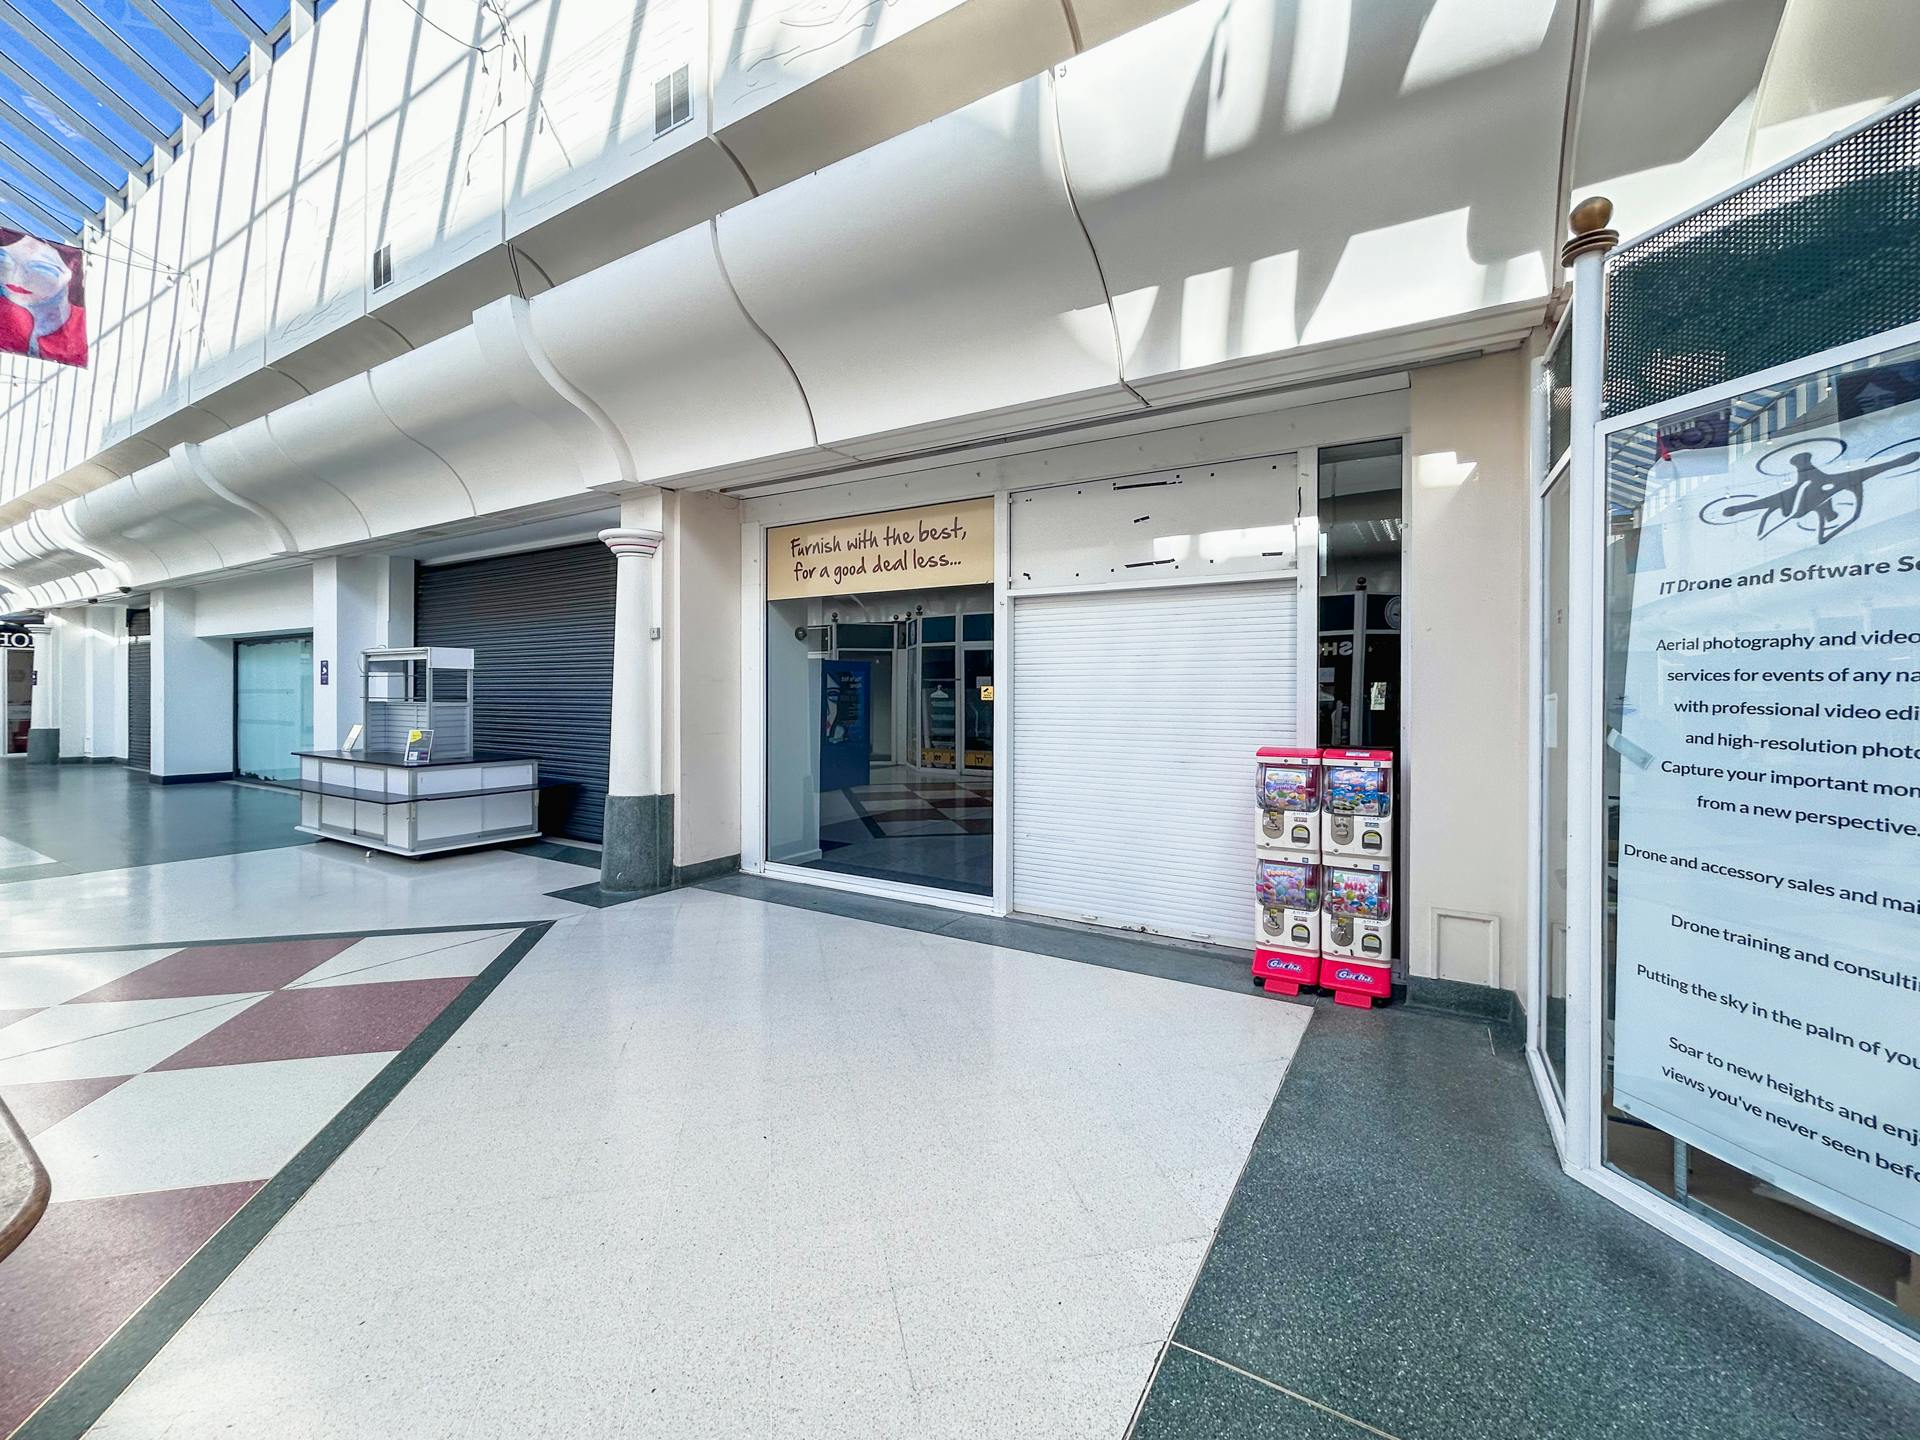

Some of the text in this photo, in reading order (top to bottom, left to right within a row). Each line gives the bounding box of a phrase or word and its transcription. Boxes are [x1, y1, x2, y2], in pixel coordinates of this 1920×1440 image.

[790, 516, 967, 557] Furnish with the best,
[794, 548, 962, 585] for a good deal less...
[1659, 555, 1920, 596] IT Drone and Software S
[1655, 636, 1700, 653] Aerial
[1702, 632, 1817, 653] photography
[1818, 630, 1858, 647] and
[1666, 668, 1731, 683] services
[1732, 667, 1760, 682] for
[1761, 668, 1825, 683] events
[1827, 667, 1851, 683] of
[1852, 670, 1893, 686] any
[1673, 699, 1710, 714] with
[1711, 701, 1821, 718] professional
[1823, 703, 1882, 720] video
[1684, 731, 1715, 746] and
[1716, 732, 1858, 756] high-resolution
[1660, 760, 1725, 779] Capture
[1725, 769, 1768, 783] your
[1770, 769, 1870, 794] important
[1696, 794, 1920, 838] from a new perspective.
[1623, 843, 1668, 864] Drone
[1669, 855, 1699, 870] and
[1700, 861, 1786, 889] accessory
[1787, 878, 1836, 897] sales
[1838, 888, 1878, 907] and
[1671, 913, 1920, 993] Drone training and consulti
[1637, 963, 1689, 995] Putting
[1690, 983, 1718, 1002] the
[1719, 993, 1750, 1014] sky
[1751, 1001, 1769, 1020] in
[1770, 1009, 1803, 1031] the
[1805, 1022, 1855, 1049] palm
[1858, 1040, 1882, 1056] of
[1668, 1036, 1920, 1148] Soar to new heights and enj
[1661, 1065, 1706, 1093] views
[1706, 1085, 1763, 1118] you've
[1765, 1109, 1819, 1141] never
[1820, 1134, 1871, 1164] seen
